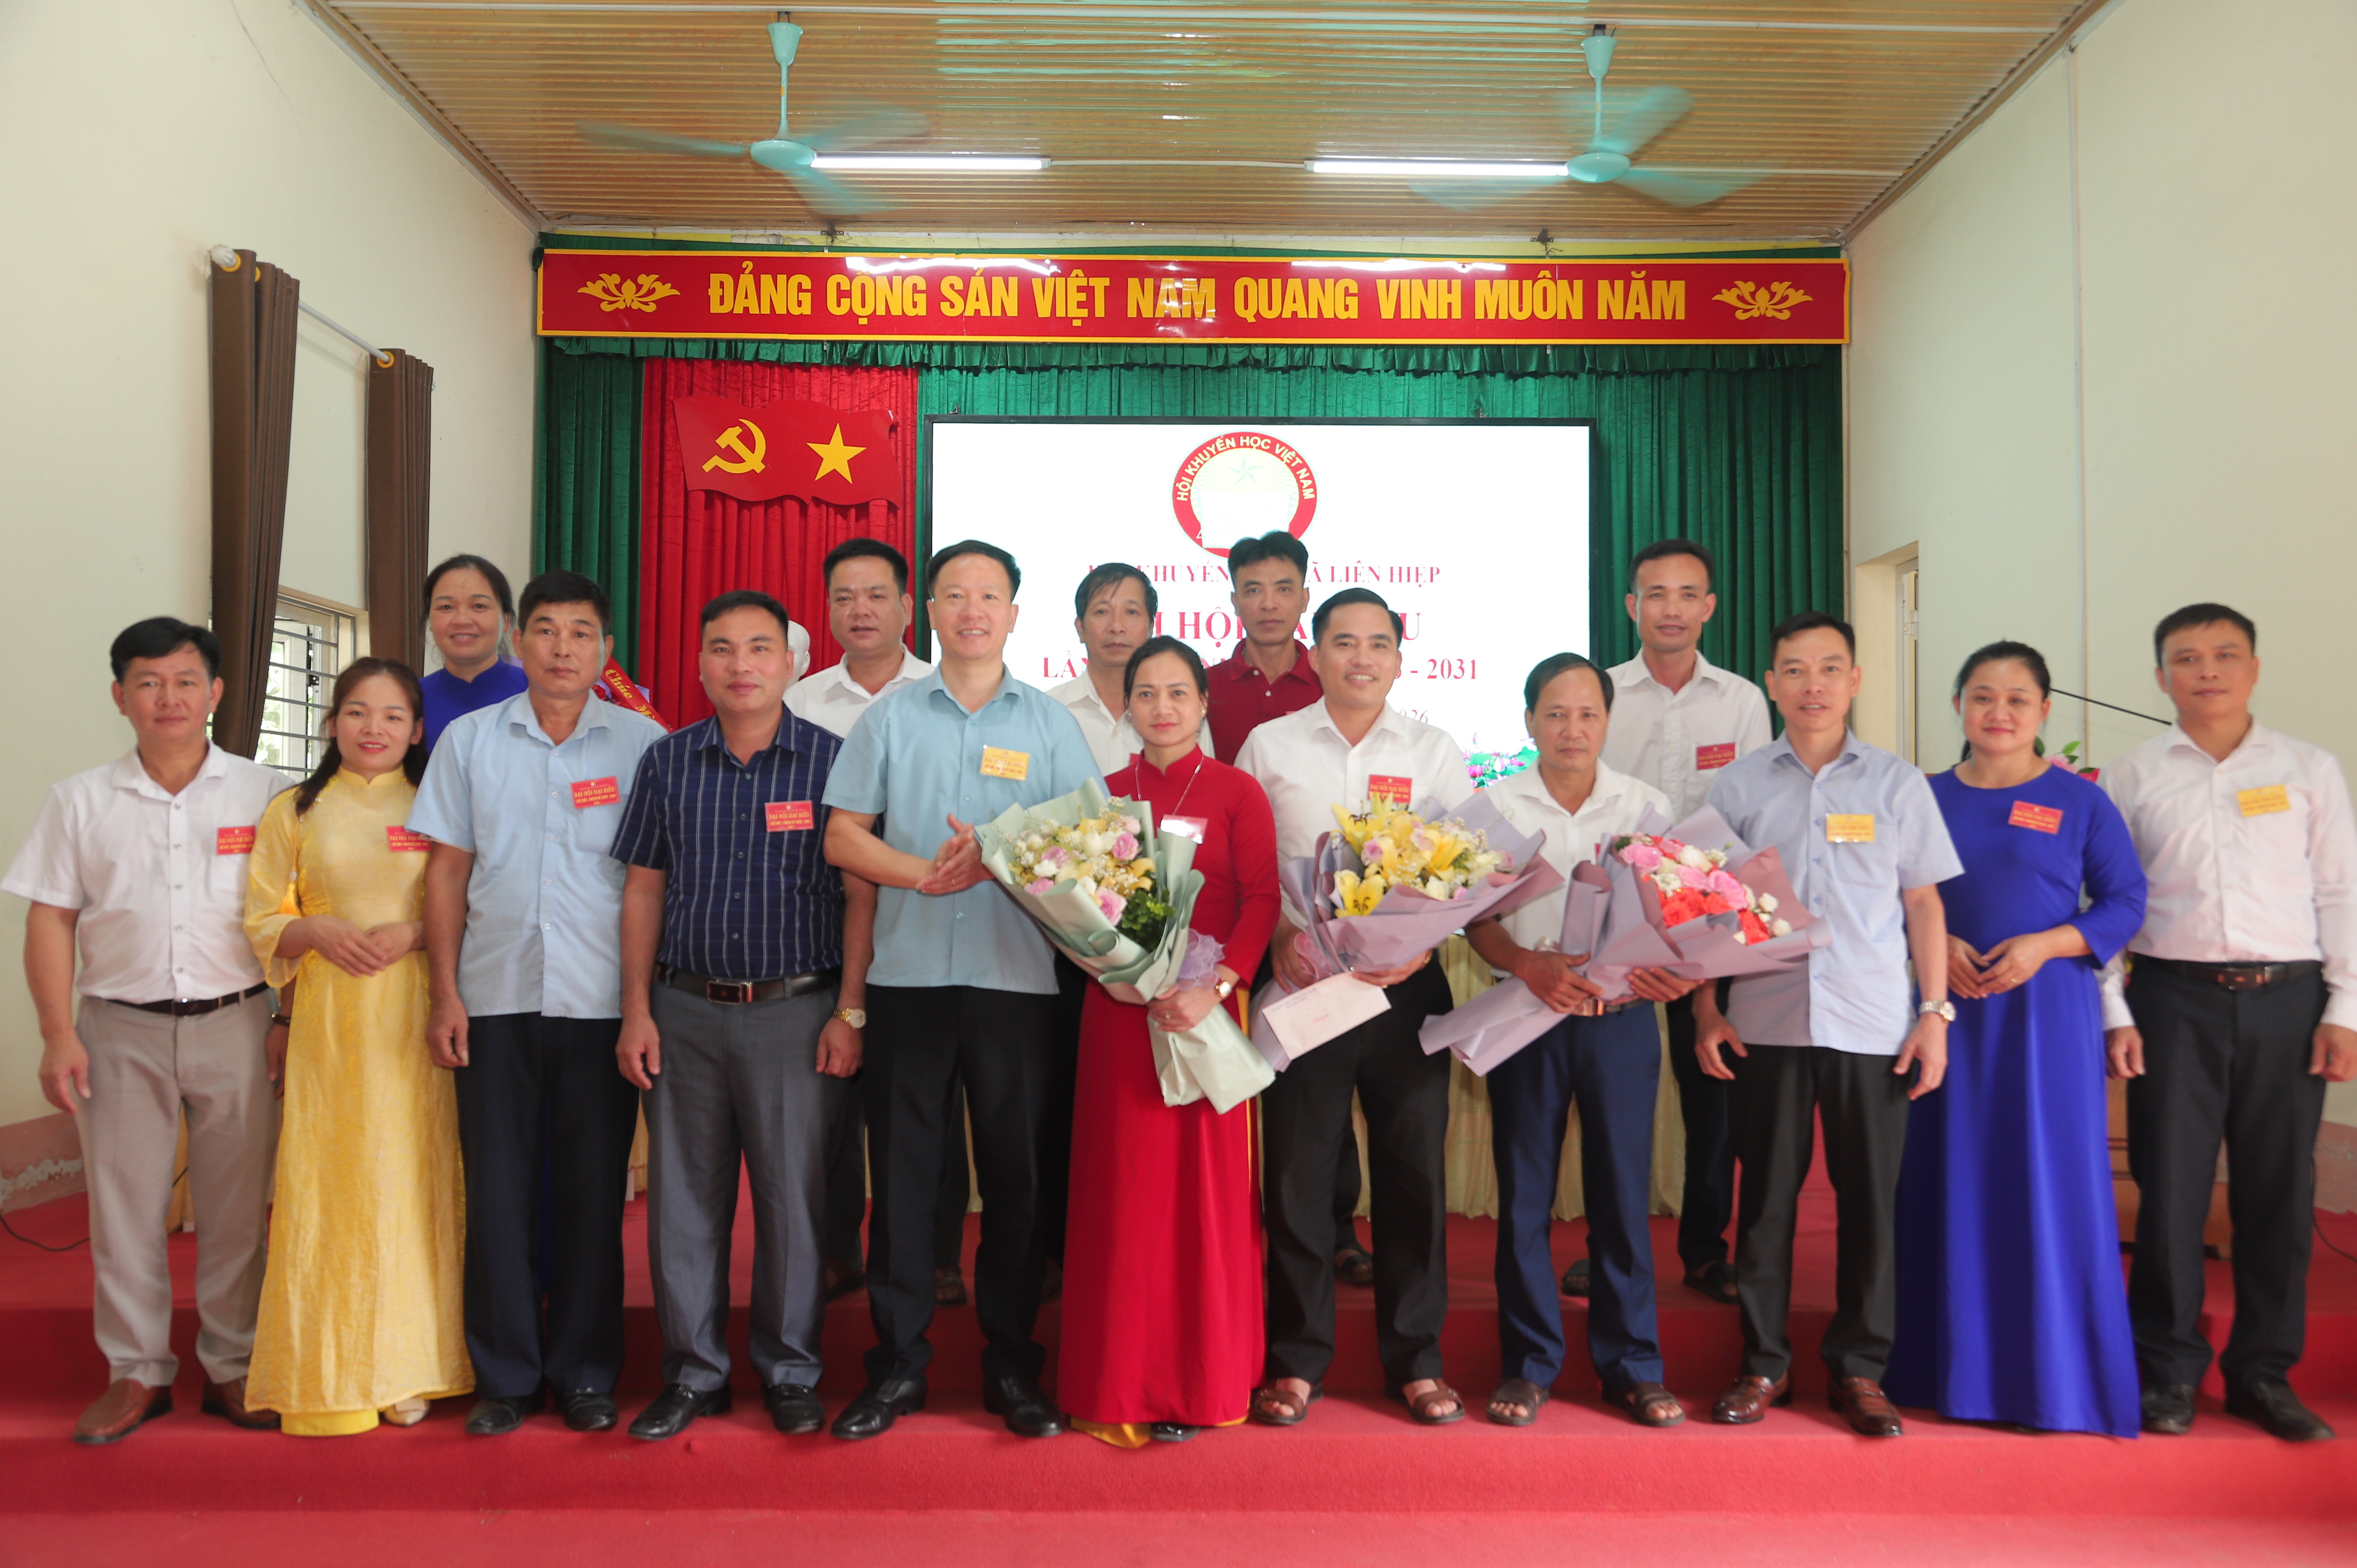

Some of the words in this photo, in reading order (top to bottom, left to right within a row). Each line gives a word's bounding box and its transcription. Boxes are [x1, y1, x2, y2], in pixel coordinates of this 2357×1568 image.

[708, 261, 811, 315] ĐẢNG
[826, 270, 926, 325] CỘNG
[1031, 269, 1110, 326] VIỆT
[1127, 278, 1216, 318] NAM
[1234, 276, 1359, 323] QUANG
[1376, 279, 1462, 319] VINH
[1474, 270, 1583, 320] MUÔN
[1597, 270, 1686, 320] NĂM
[1176, 476, 1193, 501] HỘI
[1185, 436, 1236, 476] KHUYẾN
[1240, 436, 1271, 449] HỌC
[1274, 443, 1303, 467] VIỆT
[1296, 468, 1315, 500] NAM
[1304, 561, 1321, 582] Ã
[1330, 560, 1380, 582] LIÊN
[1390, 564, 1440, 587] HIỆP
[1427, 658, 1476, 679] 2031
